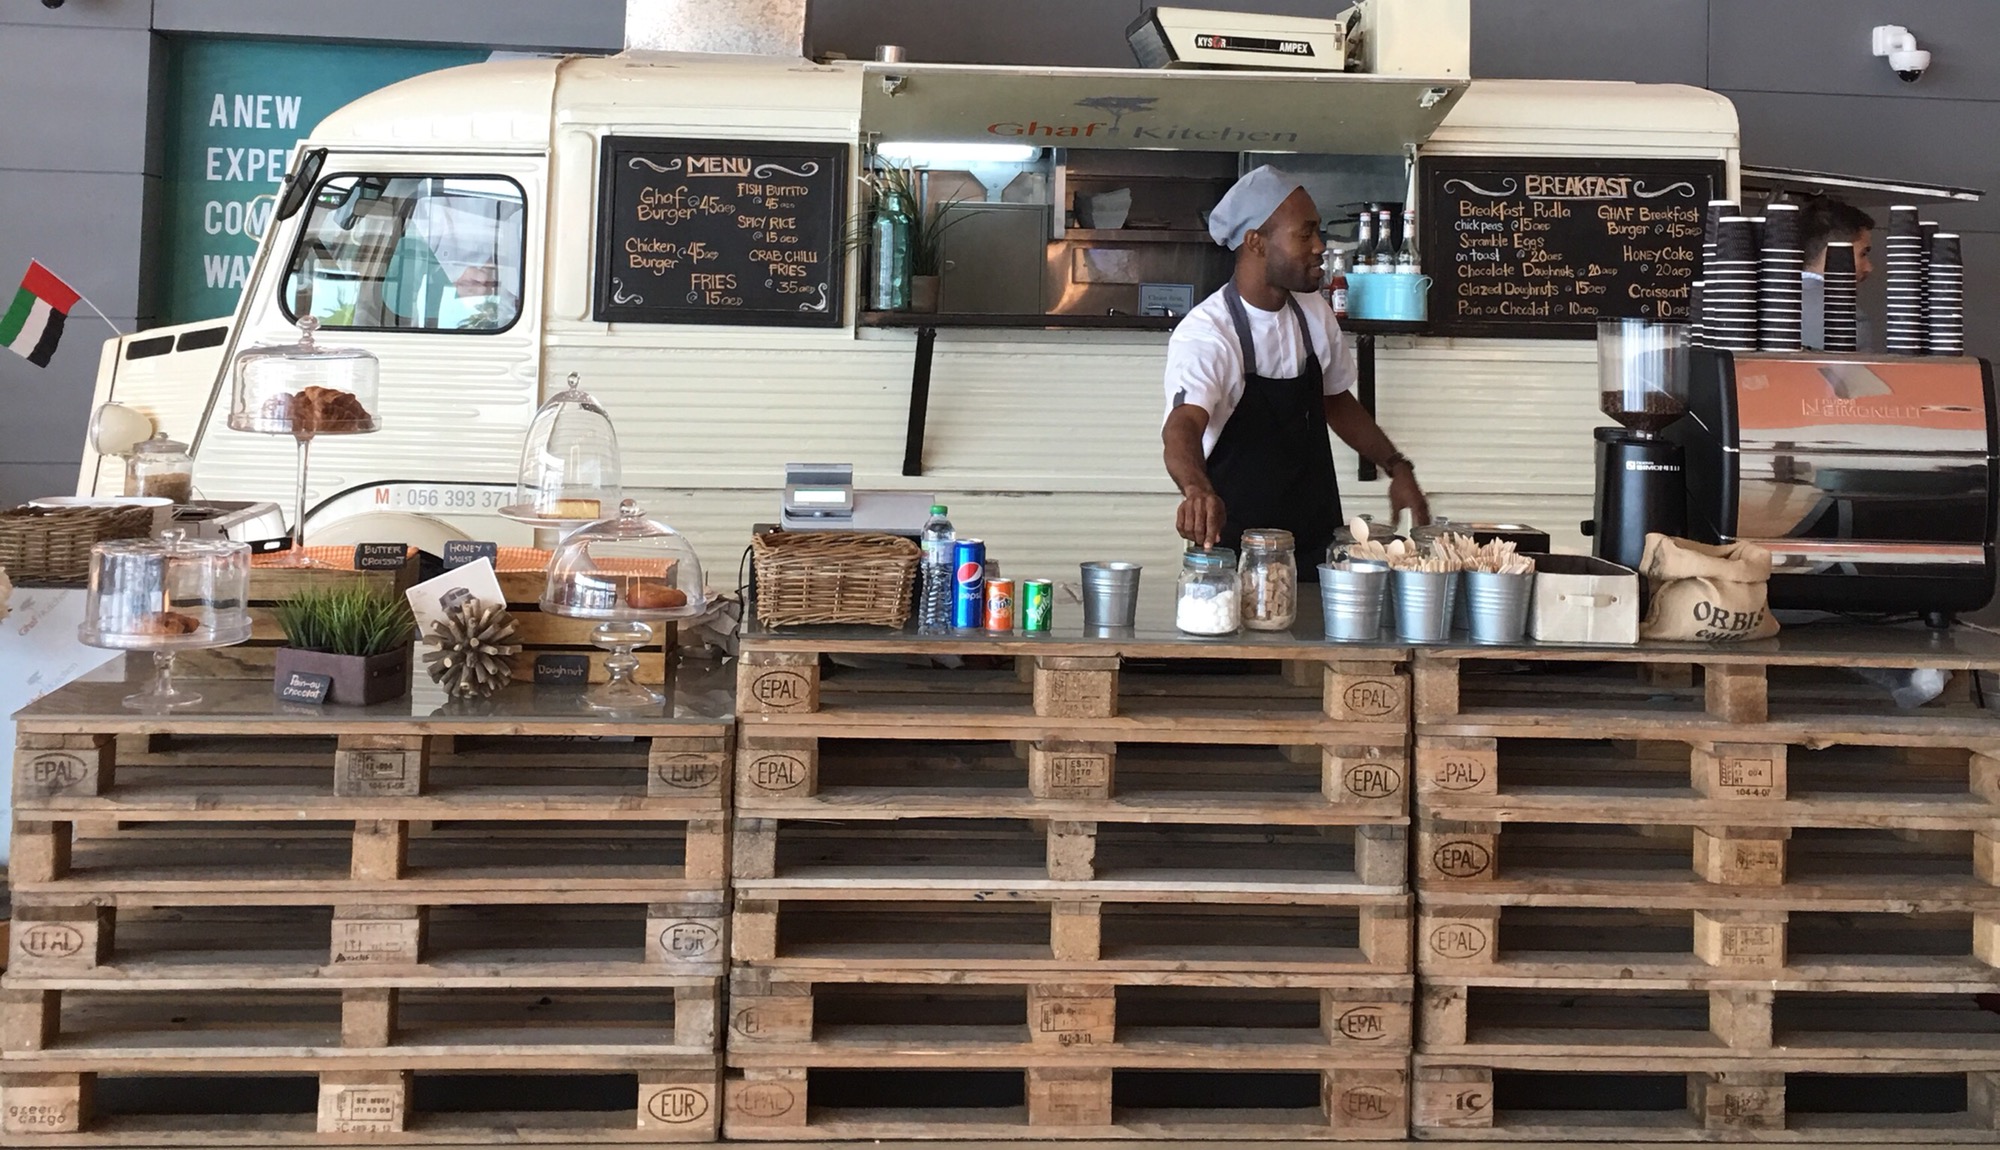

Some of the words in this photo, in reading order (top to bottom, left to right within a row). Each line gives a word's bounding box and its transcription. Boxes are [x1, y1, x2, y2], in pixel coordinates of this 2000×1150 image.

[1279, 42, 1309, 54] AMPEX
[208, 93, 228, 128] A
[234, 94, 302, 130] NEW
[987, 121, 1107, 138] Ghaf
[1133, 126, 1299, 143] Kitchen
[206, 147, 294, 183] EXPE
[687, 156, 752, 174] MENU
[737, 182, 762, 197] FISH
[1525, 175, 1632, 197] BREAKFAST
[640, 185, 688, 209] Ghaf
[765, 197, 779, 210] 45
[637, 205, 698, 226] Burger
[1460, 200, 1525, 221] Breakfast
[1533, 201, 1572, 218] Pudla
[1597, 205, 1635, 221] GHAF
[1639, 205, 1700, 223] Breakfast
[737, 215, 767, 229] SPICY
[769, 217, 797, 230] RICE
[1607, 221, 1650, 240] Burger
[625, 237, 677, 253] Chicken
[766, 231, 778, 243] 15
[1460, 232, 1509, 249] Scramble
[1513, 233, 1545, 251] Eggs
[749, 249, 783, 262] CRAB
[1455, 253, 1468, 262] on
[1469, 247, 1500, 262] toast
[1662, 245, 1694, 261] Cake
[630, 254, 680, 277] Burger
[769, 263, 807, 277] FRIES
[1458, 262, 1515, 278] Chocolate
[1522, 262, 1575, 279] Doughnuts
[691, 273, 737, 291] FRIES
[1458, 282, 1502, 297] Glazed
[1504, 280, 1560, 300] Doughnuts
[1628, 282, 1690, 299] Croissant
[1458, 300, 1483, 316] Pain
[1500, 300, 1550, 316] Chocolat
[375, 488, 390, 505] M
[407, 490, 438, 506] 056
[444, 490, 476, 508] 393
[364, 545, 402, 555] BUTTER
[449, 543, 482, 553] HONEY
[537, 663, 585, 679] Doughnut
[761, 679, 799, 699] EPAL
[1351, 688, 1391, 709] EPAL
[34, 760, 77, 783] EPAL
[758, 761, 796, 784] EPAL
[1435, 762, 1479, 783] EPAL
[1353, 770, 1391, 793] EPAL
[1441, 849, 1481, 870] EPAL
[672, 928, 706, 951] EUR
[1438, 930, 1478, 951] EPAL
[9, 1105, 58, 1118] green
[660, 1093, 696, 1118] EUR
[1347, 1093, 1388, 1114] EPAL
[18, 1114, 66, 1127] cargo
